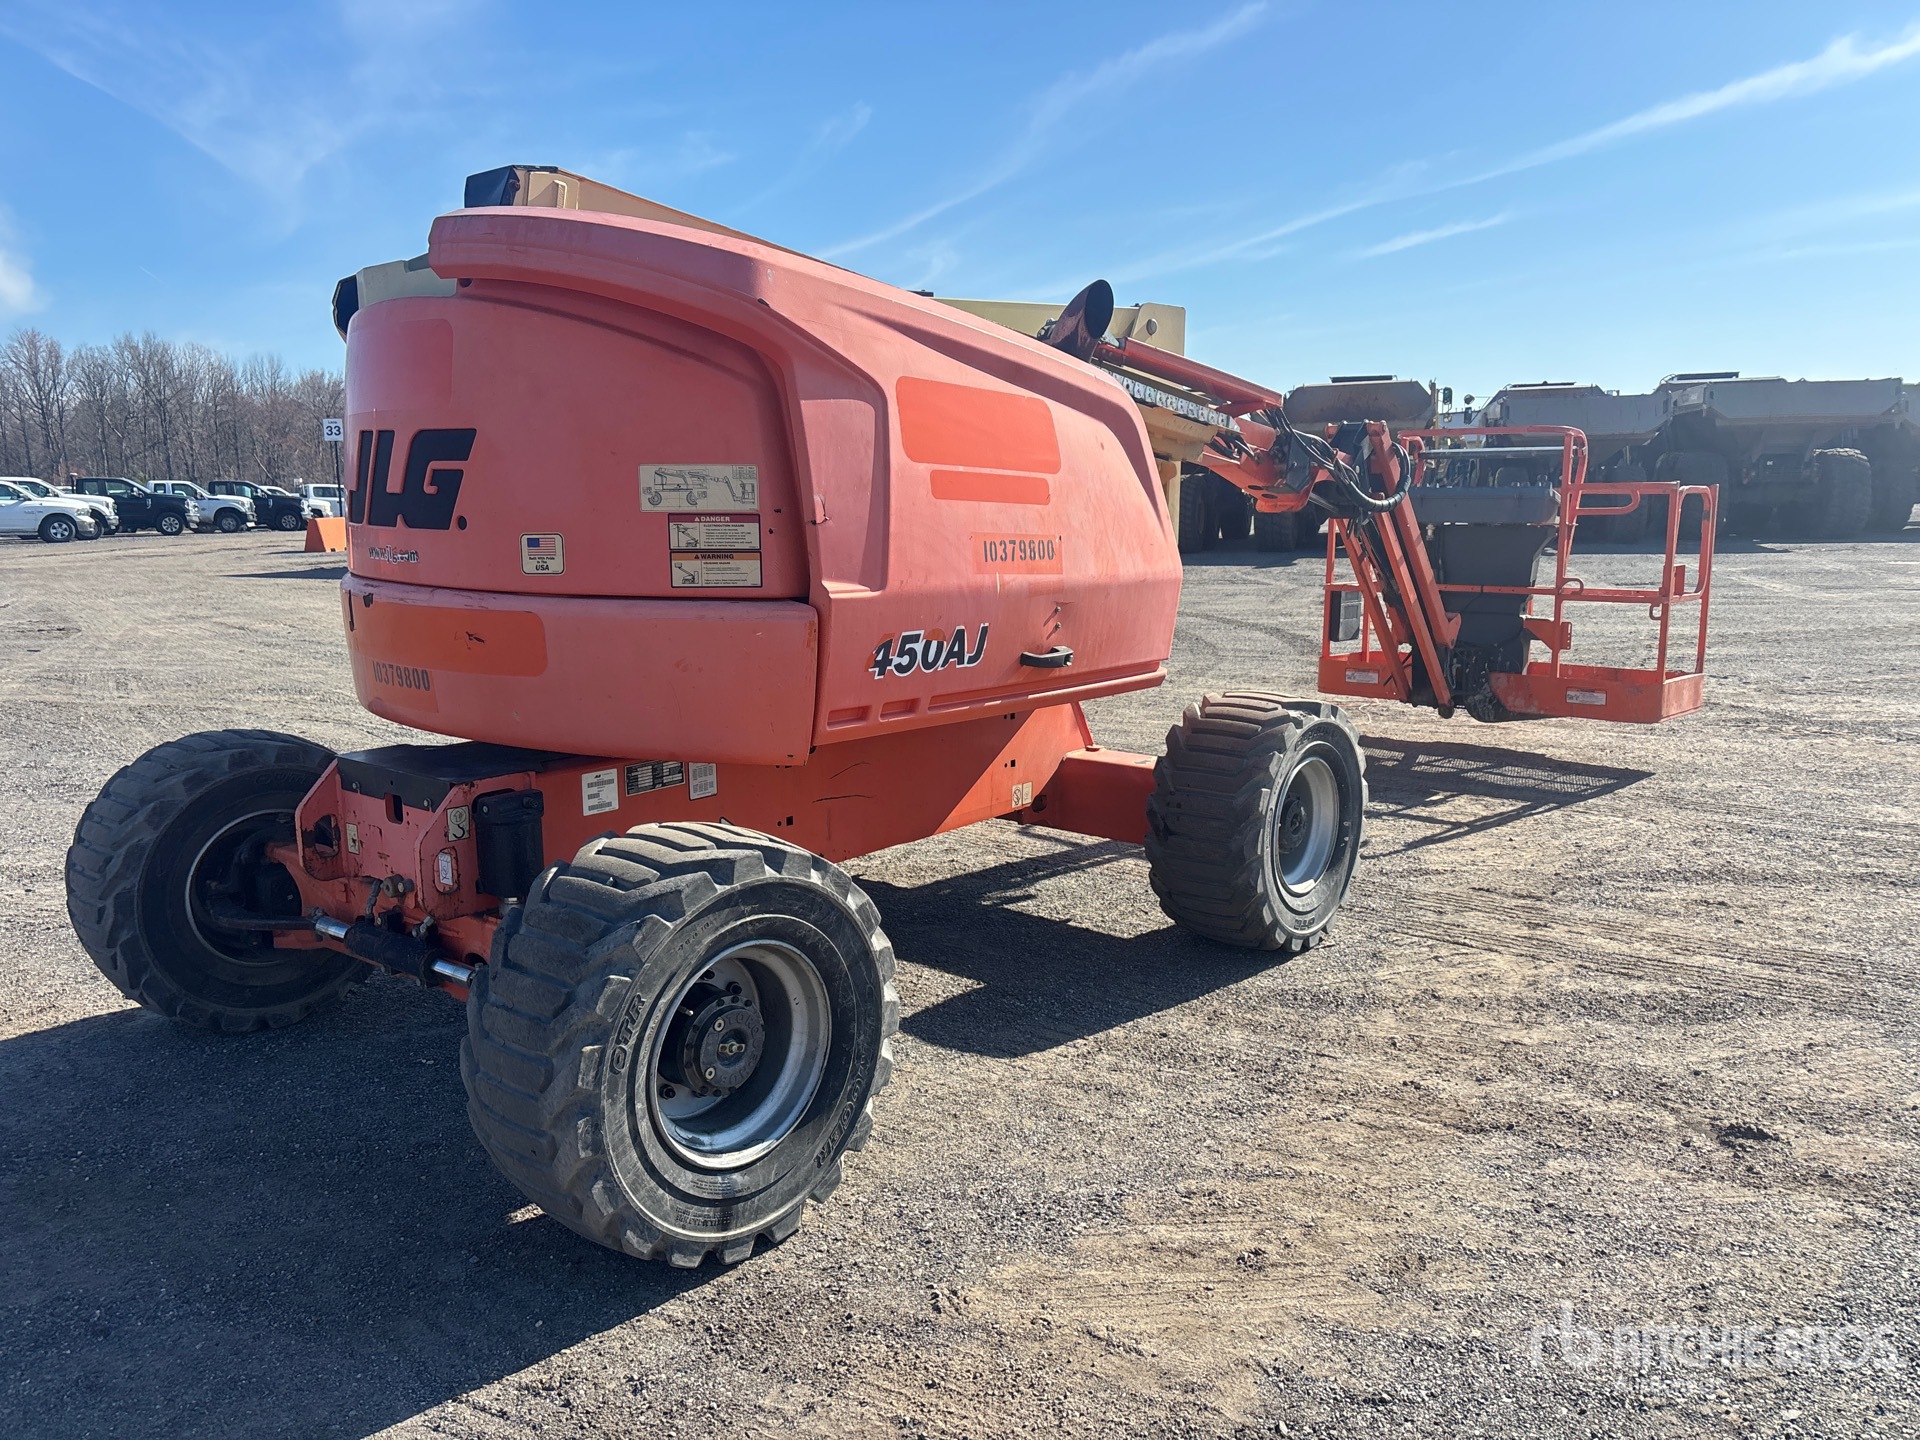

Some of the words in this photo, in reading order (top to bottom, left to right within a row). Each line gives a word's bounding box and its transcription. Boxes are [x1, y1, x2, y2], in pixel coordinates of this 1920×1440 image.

[325, 425, 341, 436] 33
[348, 428, 477, 530] JLG
[983, 539, 1055, 562] 10379800
[869, 623, 990, 680] 450AJ
[372, 660, 431, 692] 10379800
[608, 993, 646, 1076] OTR
